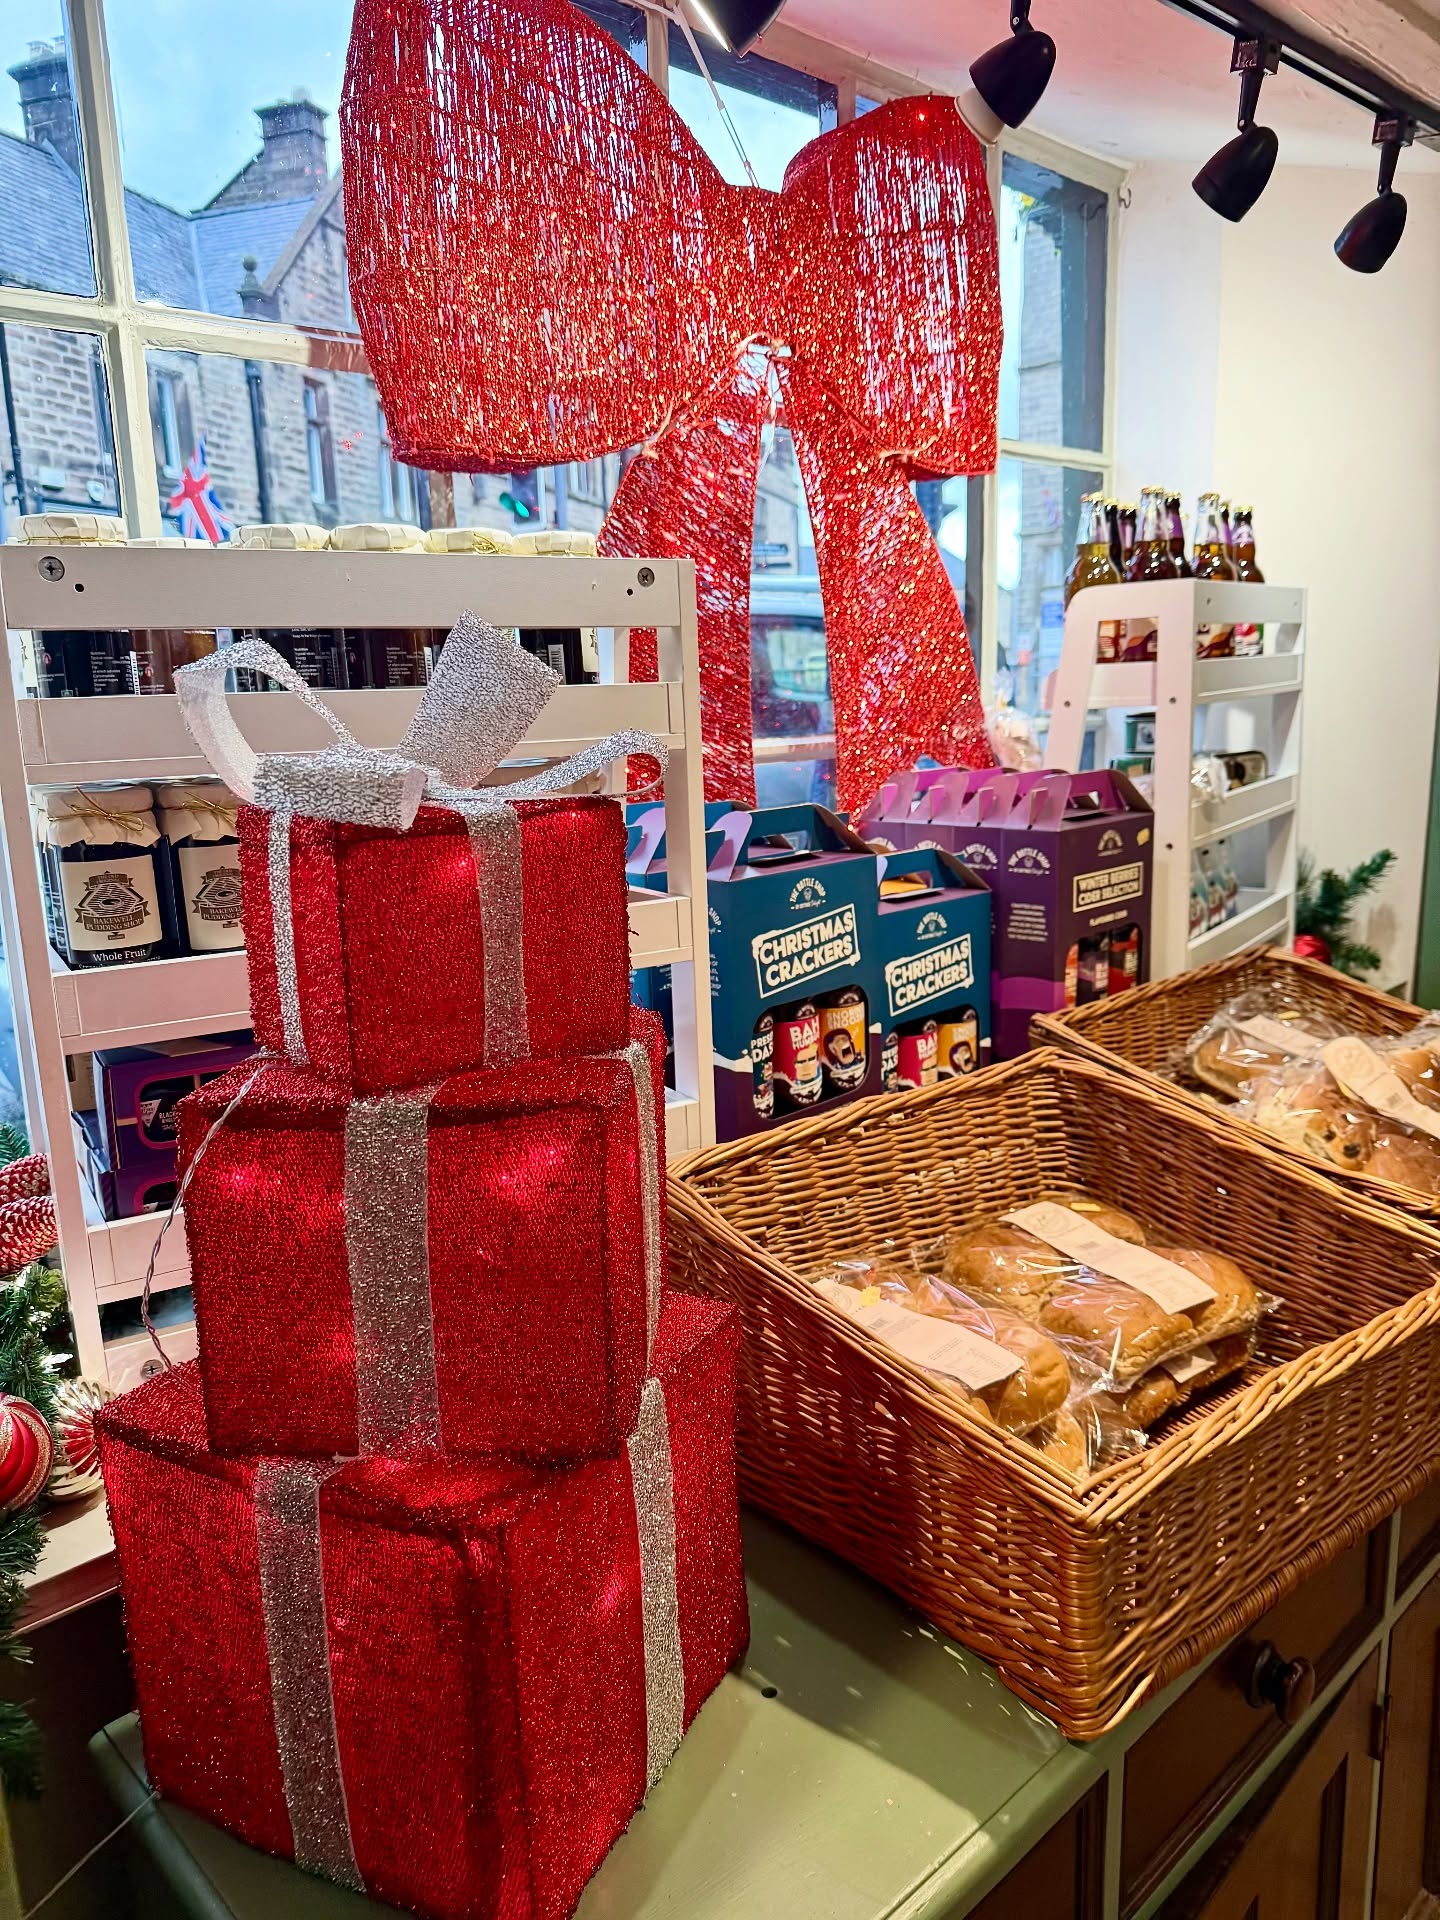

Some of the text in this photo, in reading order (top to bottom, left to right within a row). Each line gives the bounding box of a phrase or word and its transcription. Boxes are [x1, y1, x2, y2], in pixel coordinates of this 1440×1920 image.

[796, 877, 814, 891] BOTTLE
[814, 880, 826, 896] SHOP
[1079, 867, 1139, 892] WINTER BERRIES
[1079, 880, 1139, 906] CIDER SELECTION
[87, 918, 142, 931] PUDDING SHOP
[93, 914, 133, 925] BAKEWELL
[760, 911, 854, 965] CHRISTMAS
[93, 952, 122, 962] Whole
[125, 948, 147, 959] Fruit
[766, 935, 853, 987] CRACKERS
[891, 940, 969, 988] CHRISTMAS
[895, 961, 967, 1007] CRACKERS
[789, 1015, 820, 1041] BAH
